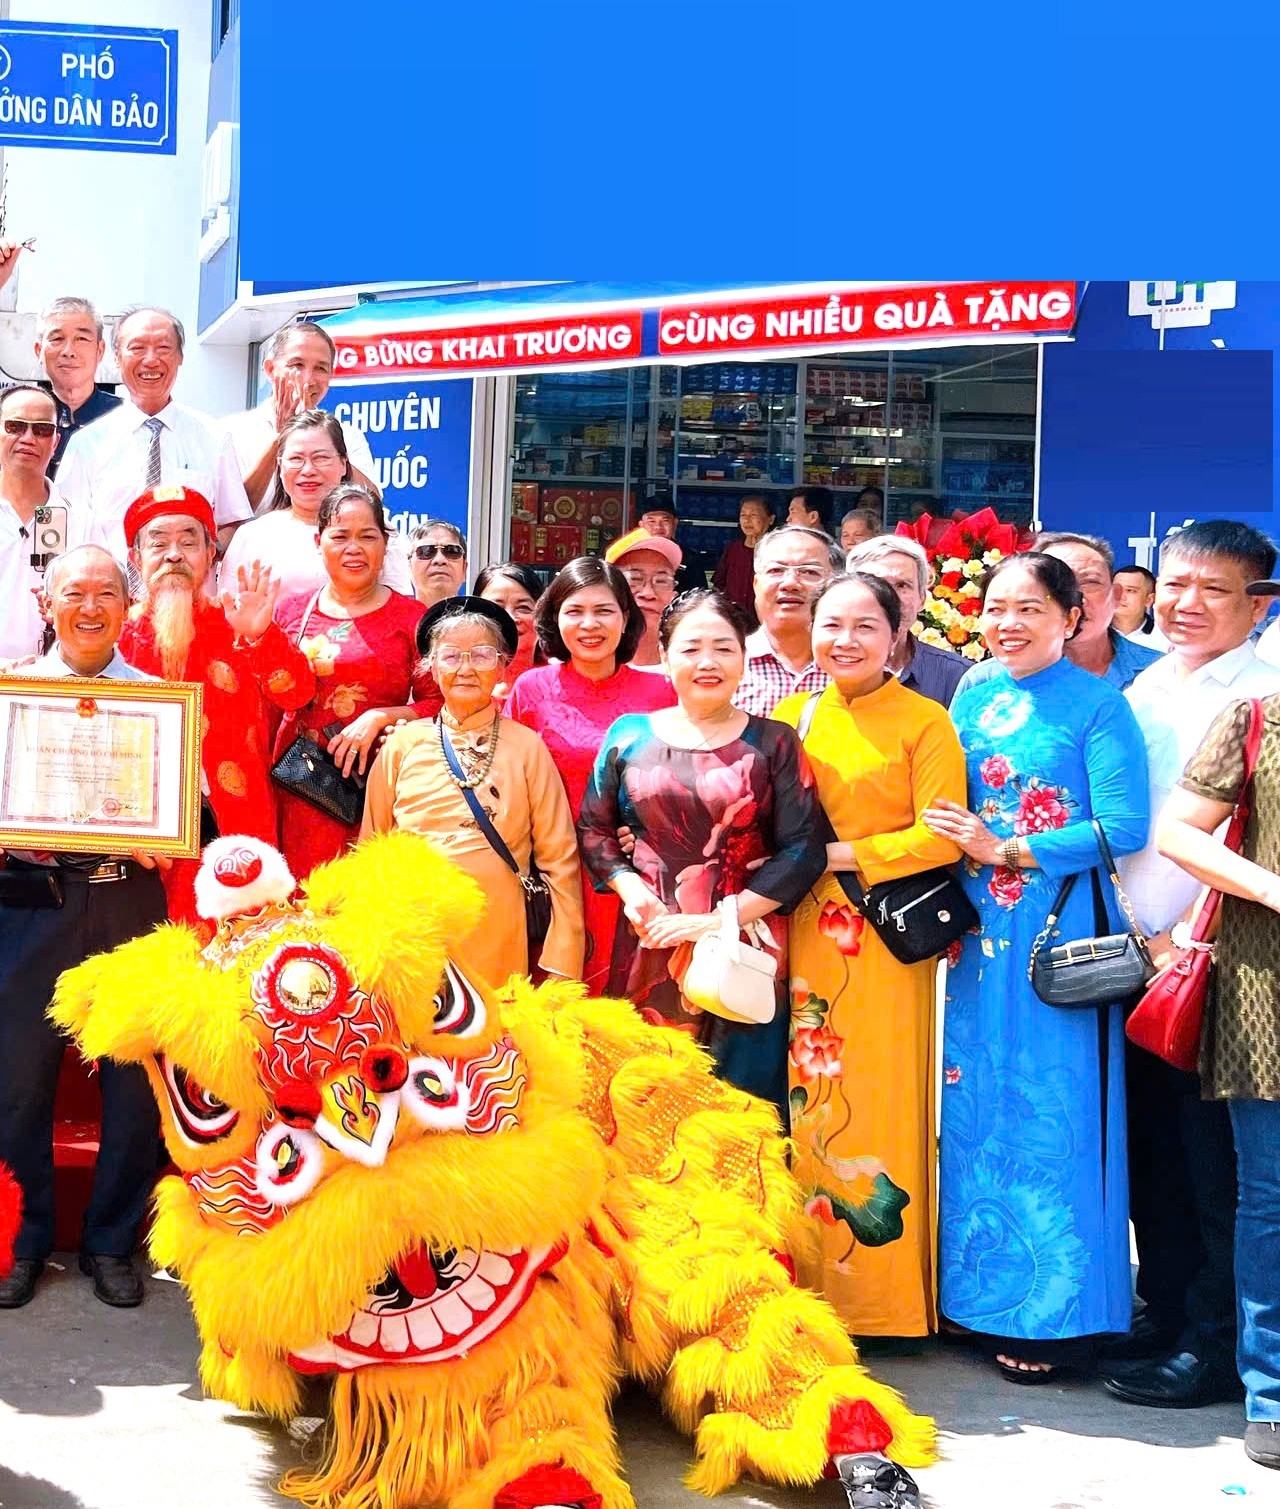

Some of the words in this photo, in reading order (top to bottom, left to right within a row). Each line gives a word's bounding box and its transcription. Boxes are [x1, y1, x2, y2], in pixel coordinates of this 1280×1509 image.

[61, 45, 115, 80] PHỐ
[54, 93, 102, 127] DÂN
[111, 92, 159, 129] BẢO
[661, 311, 757, 345] CÙNG
[765, 294, 864, 338] NHIỀU
[873, 291, 954, 331] QUÀ
[964, 288, 1072, 331] TẶNG
[363, 338, 434, 367] BỪNG
[440, 335, 506, 362] KHAI
[513, 324, 633, 357] TRƯƠNG
[334, 391, 441, 433] CHUYÊN
